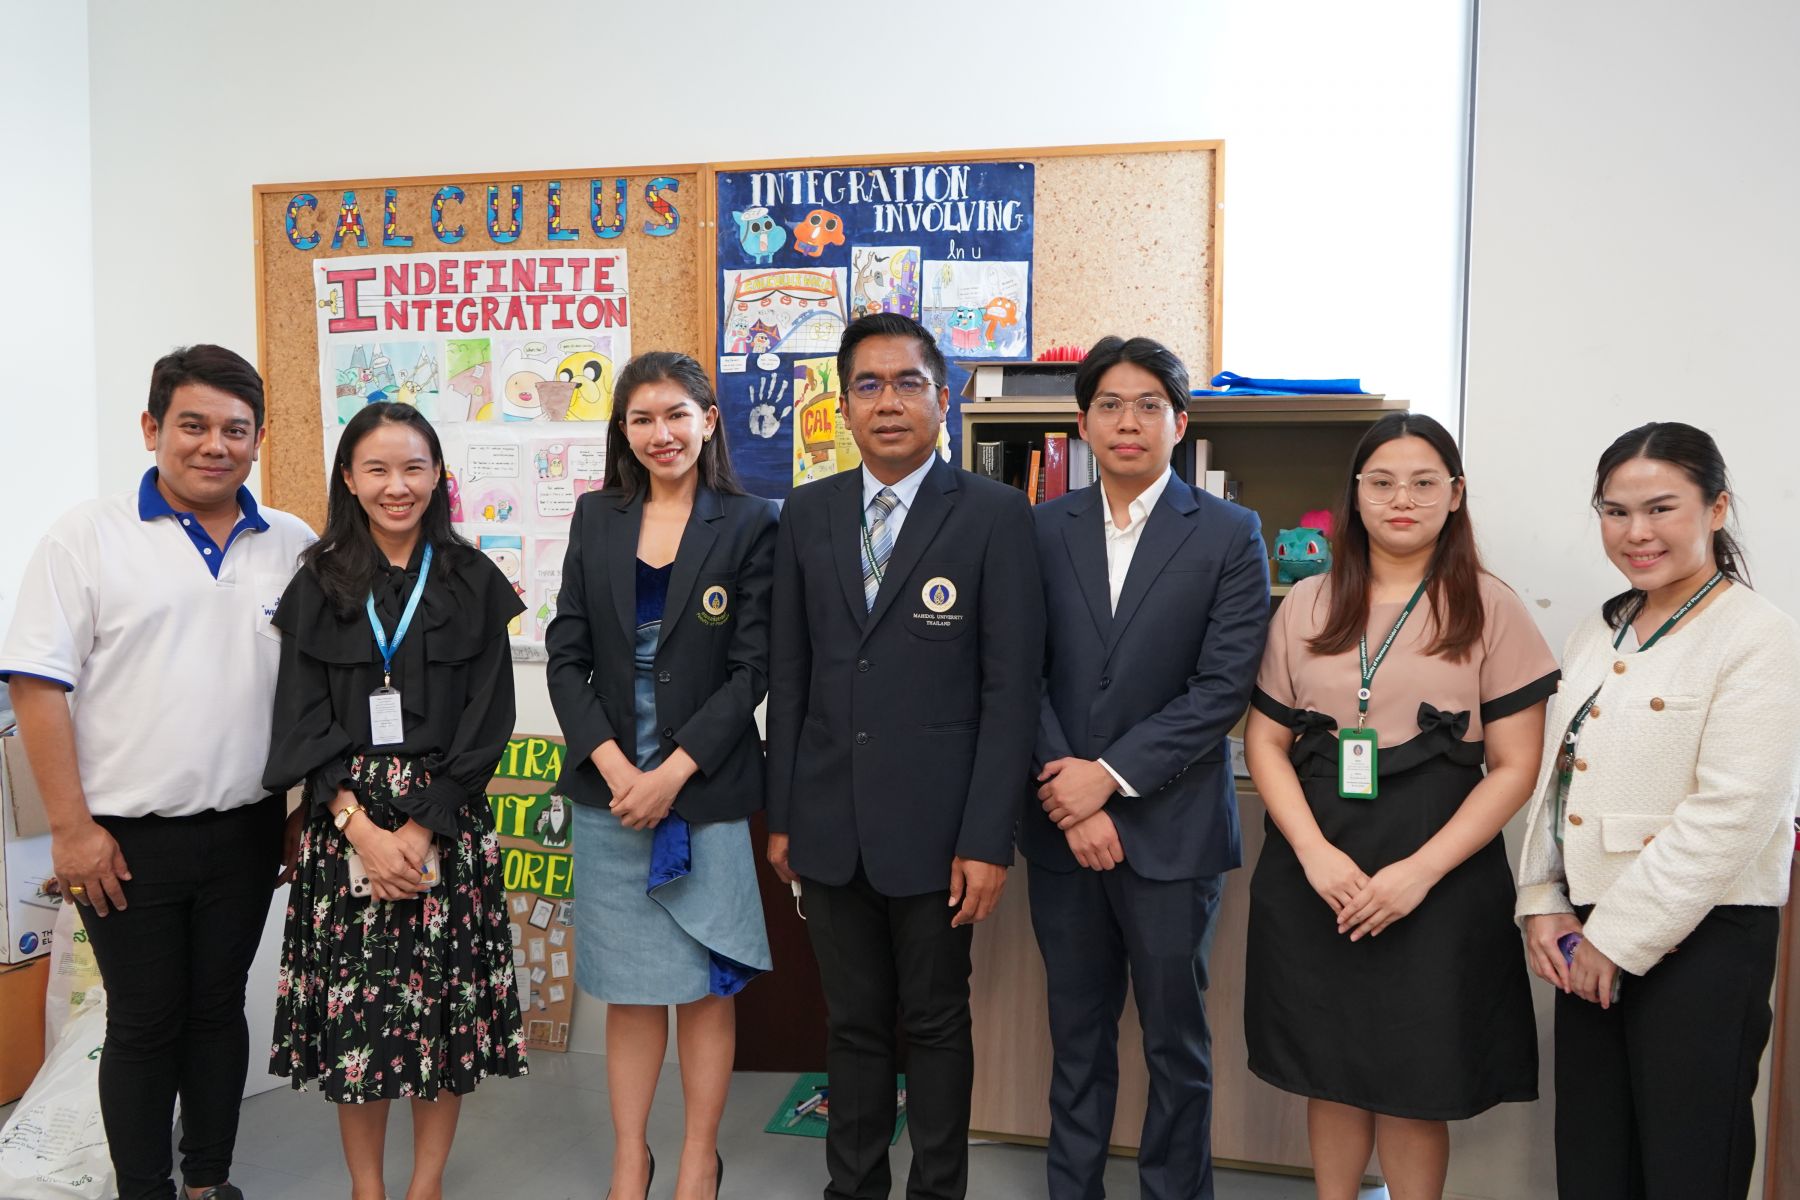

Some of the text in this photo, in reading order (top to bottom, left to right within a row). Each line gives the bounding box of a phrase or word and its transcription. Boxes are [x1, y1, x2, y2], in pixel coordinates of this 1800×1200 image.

[750, 165, 970, 207] INTEGRATION
[285, 177, 680, 250] CALCULUS
[873, 200, 1024, 233] INVOLVING
[805, 408, 832, 438] CAL
[1672, 606, 1688, 620] Faculty
[1690, 584, 1710, 603] Pharmacy
[1365, 666, 1375, 680] Faculty
[1375, 643, 1389, 661] Pharmacy
[1386, 628, 1397, 645] Mahidol
[1395, 610, 1409, 629] University
[495, 738, 563, 782] TRA
[502, 849, 574, 898] ORE
[41, 929, 53, 938] TH
[42, 938, 53, 946] EL
